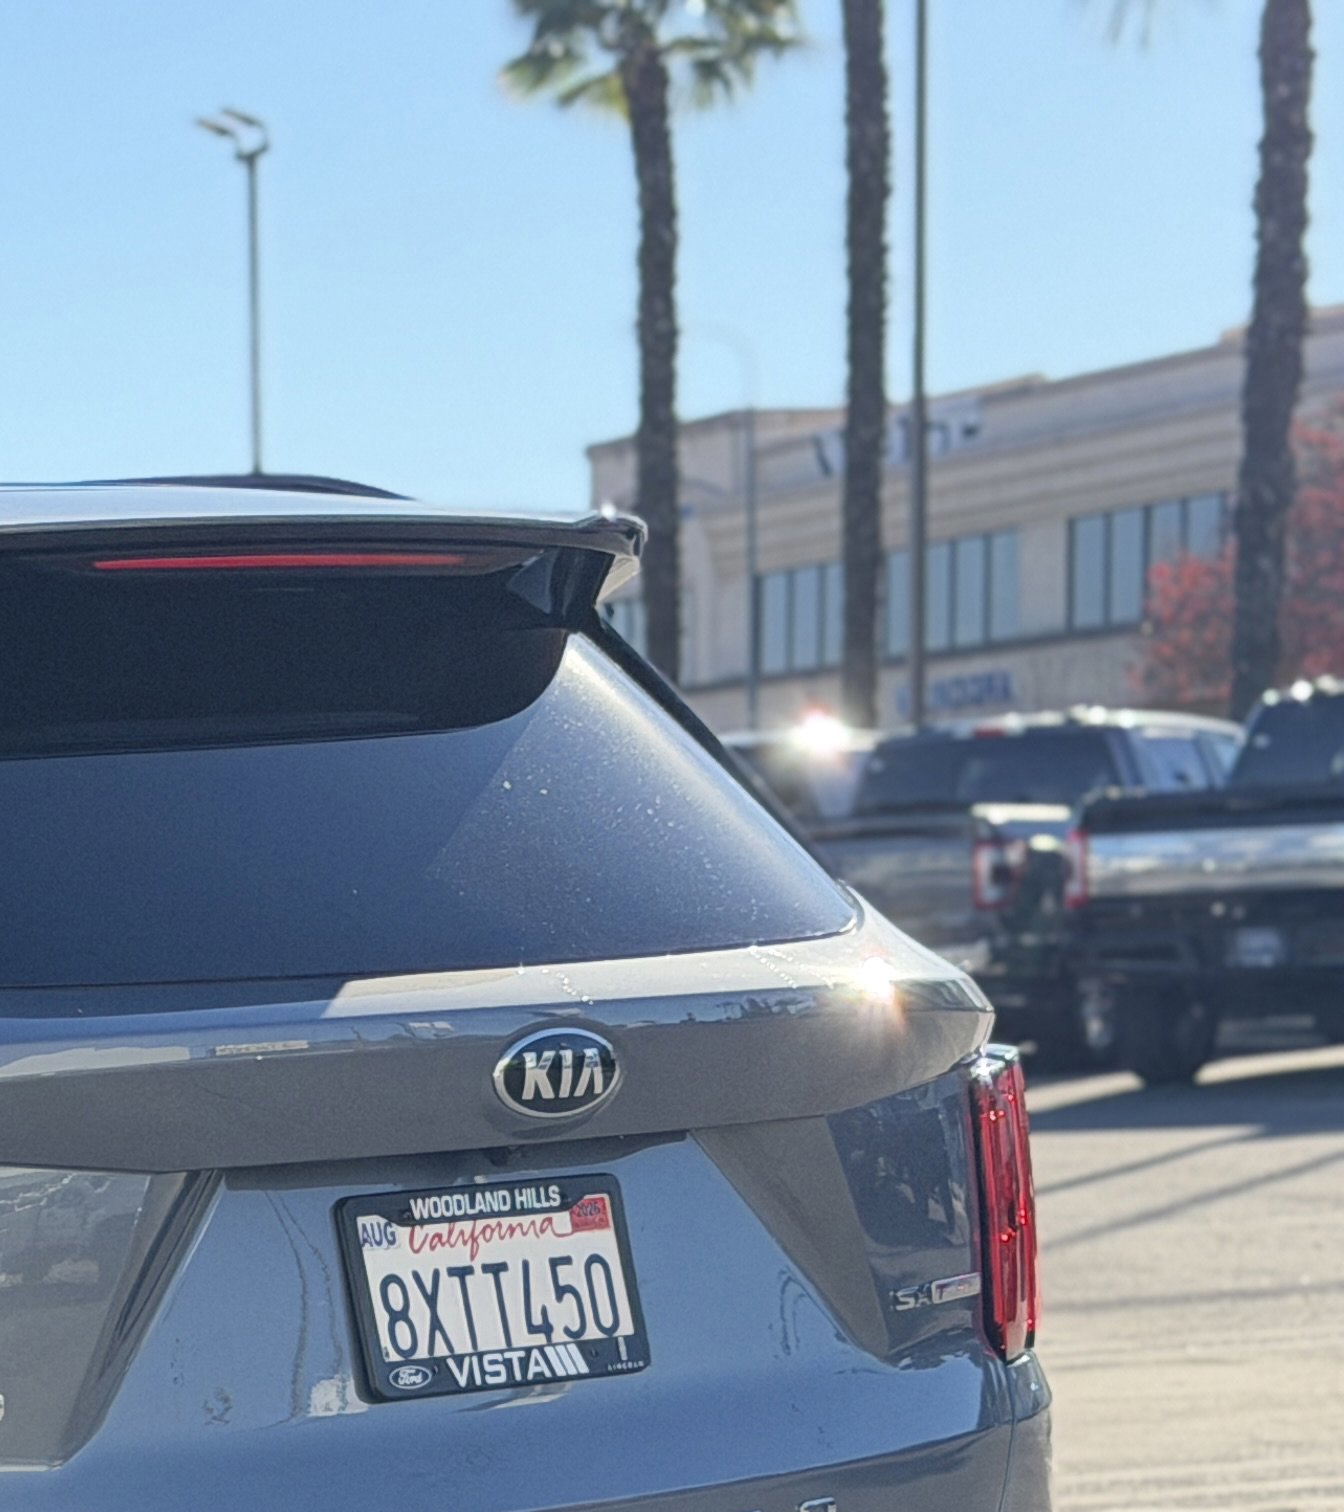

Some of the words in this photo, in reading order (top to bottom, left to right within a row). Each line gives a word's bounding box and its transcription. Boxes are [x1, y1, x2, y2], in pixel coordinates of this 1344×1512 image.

[522, 1048, 603, 1100] KIA
[410, 1189, 511, 1220] WOODLAND
[514, 1185, 561, 1210] HILLS
[362, 1222, 397, 1247] AUG
[409, 1216, 572, 1262] California
[379, 1253, 621, 1359] 8XTT450
[446, 1347, 562, 1387] VISTA
